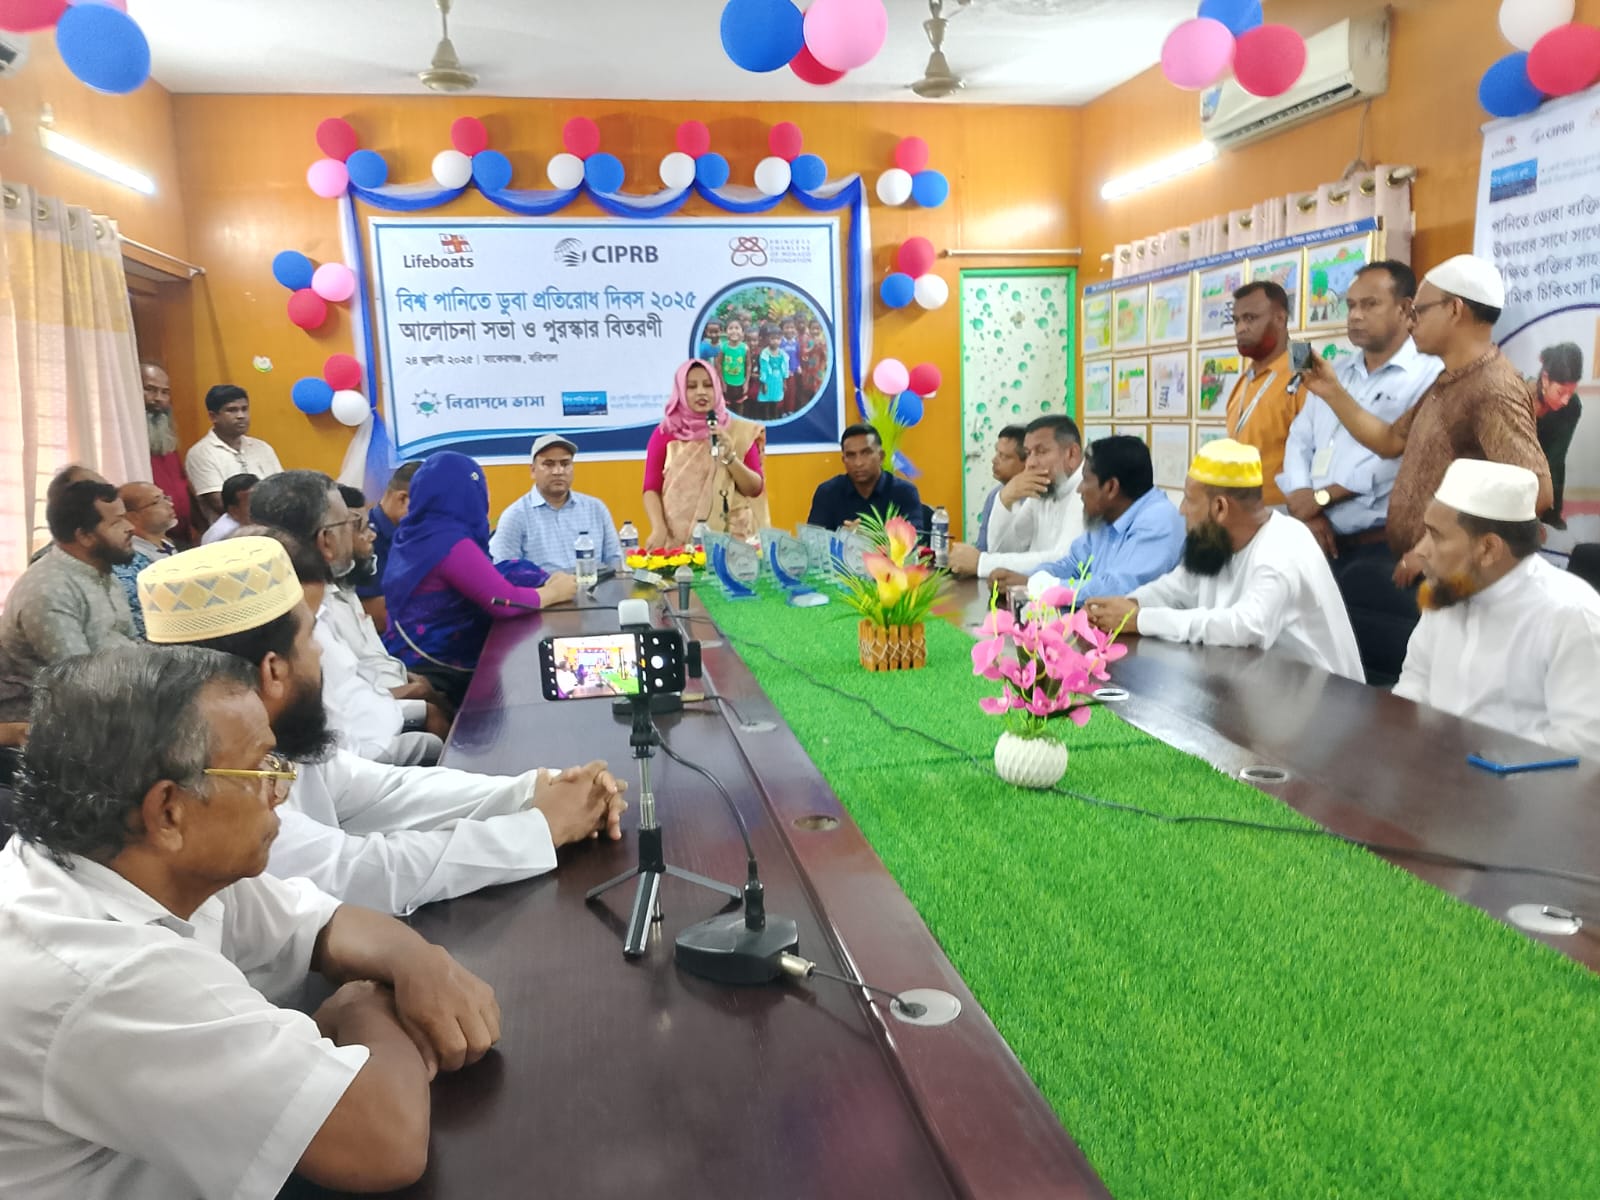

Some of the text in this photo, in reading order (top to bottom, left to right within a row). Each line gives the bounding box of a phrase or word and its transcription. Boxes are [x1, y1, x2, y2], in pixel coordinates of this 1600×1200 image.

[1491, 212, 1529, 232] পানিতে
[1533, 205, 1564, 225] ডোবা
[1540, 231, 1568, 248] সাথে
[403, 254, 474, 268] Lifeboats
[591, 245, 659, 263] CIPRB
[1537, 280, 1587, 301] চিকিৎসা
[395, 285, 697, 317] বিশ্ব পানিতে ডুবা প্রতিরোধ দিবস ২০২৫
[398, 312, 663, 344] আলোচনা সভা ও পুরস্কার বিতরণী
[448, 355, 473, 365] ২০২৫
